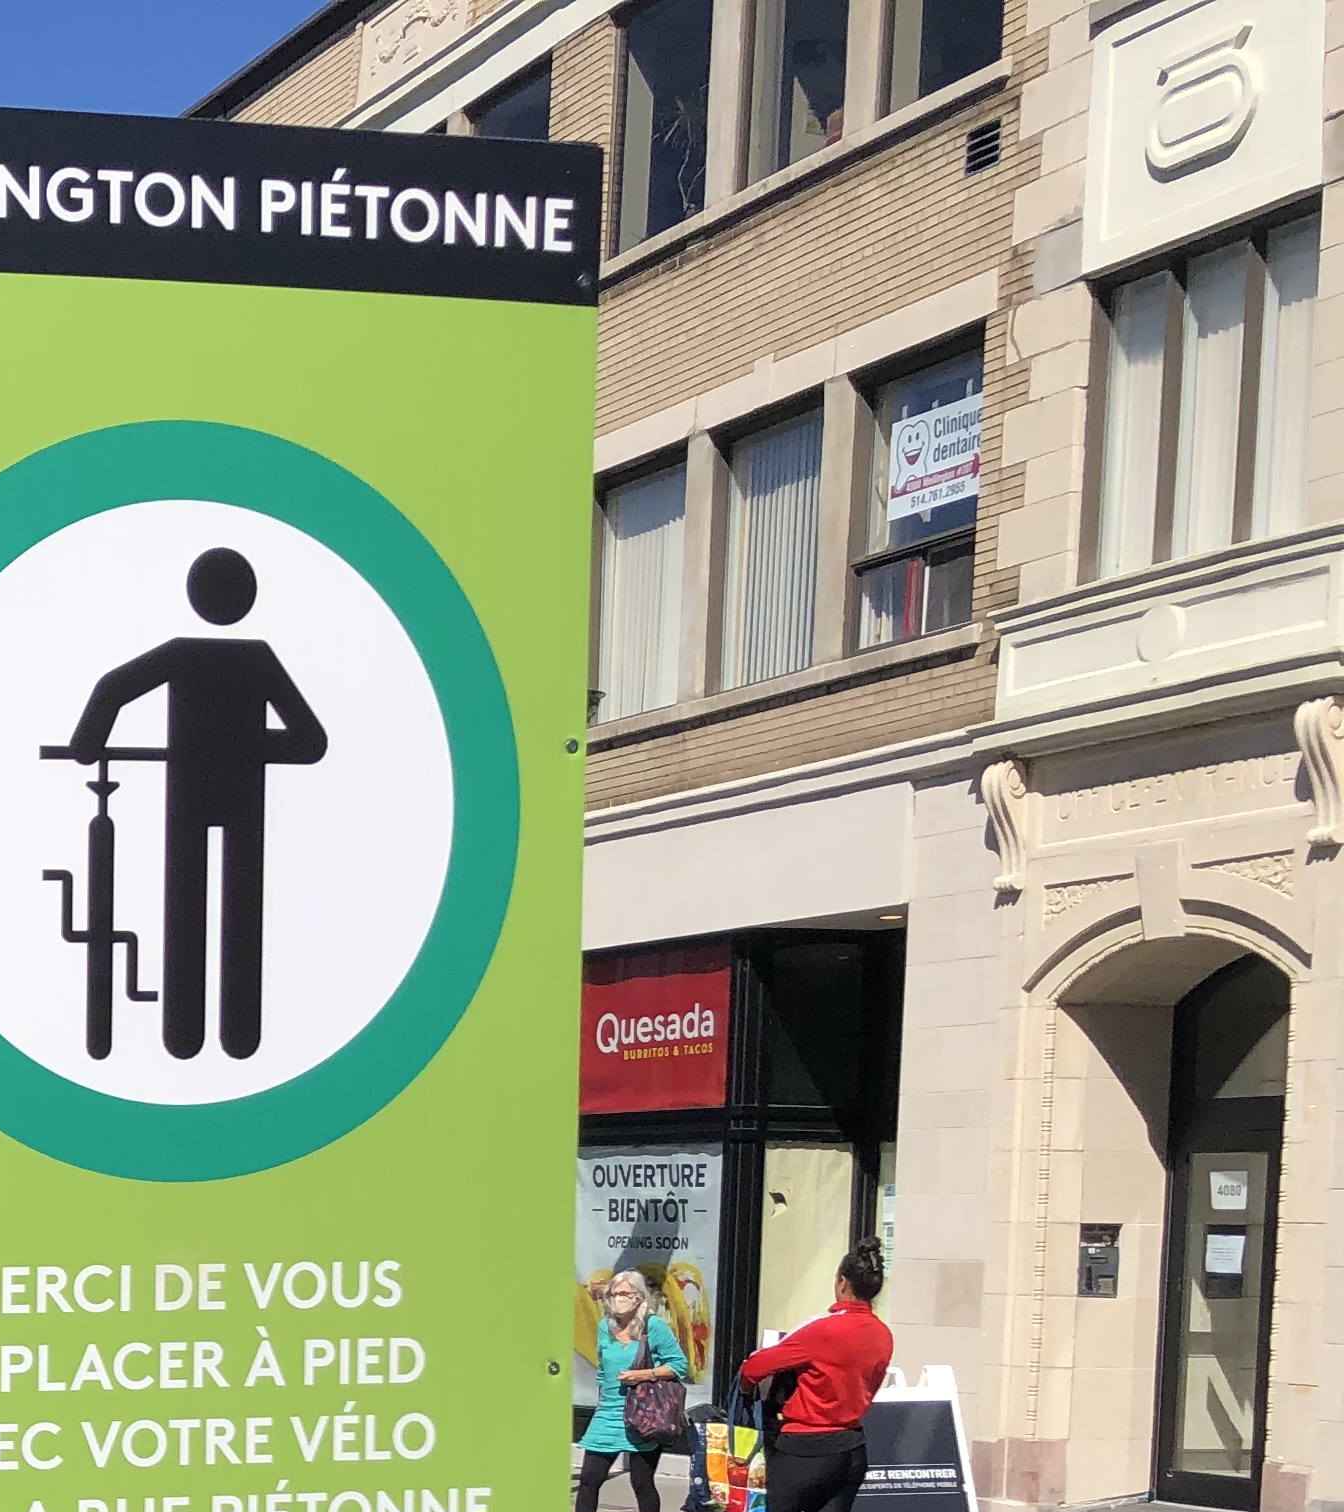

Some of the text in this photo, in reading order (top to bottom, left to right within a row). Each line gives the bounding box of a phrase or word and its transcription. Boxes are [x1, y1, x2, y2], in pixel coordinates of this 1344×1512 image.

[261, 168, 574, 252] PIÉTONNE
[934, 407, 982, 438] Clinique
[596, 1002, 716, 1054] Quesada
[623, 1042, 714, 1061] BURRITOS & TACOS
[592, 1163, 708, 1189] OUVERTURE
[1216, 1184, 1242, 1197] 4080
[607, 1190, 689, 1223] BIENTÔT
[607, 1235, 689, 1250] OPENING SOON
[154, 1263, 227, 1312] DE
[243, 1260, 403, 1310] VOUS
[243, 1325, 286, 1388] À
[303, 1337, 426, 1386] PIED
[80, 1417, 274, 1469] VOTRE
[290, 1400, 437, 1463] VÉLO
[864, 1468, 958, 1480] NEZ RENCONTRER
